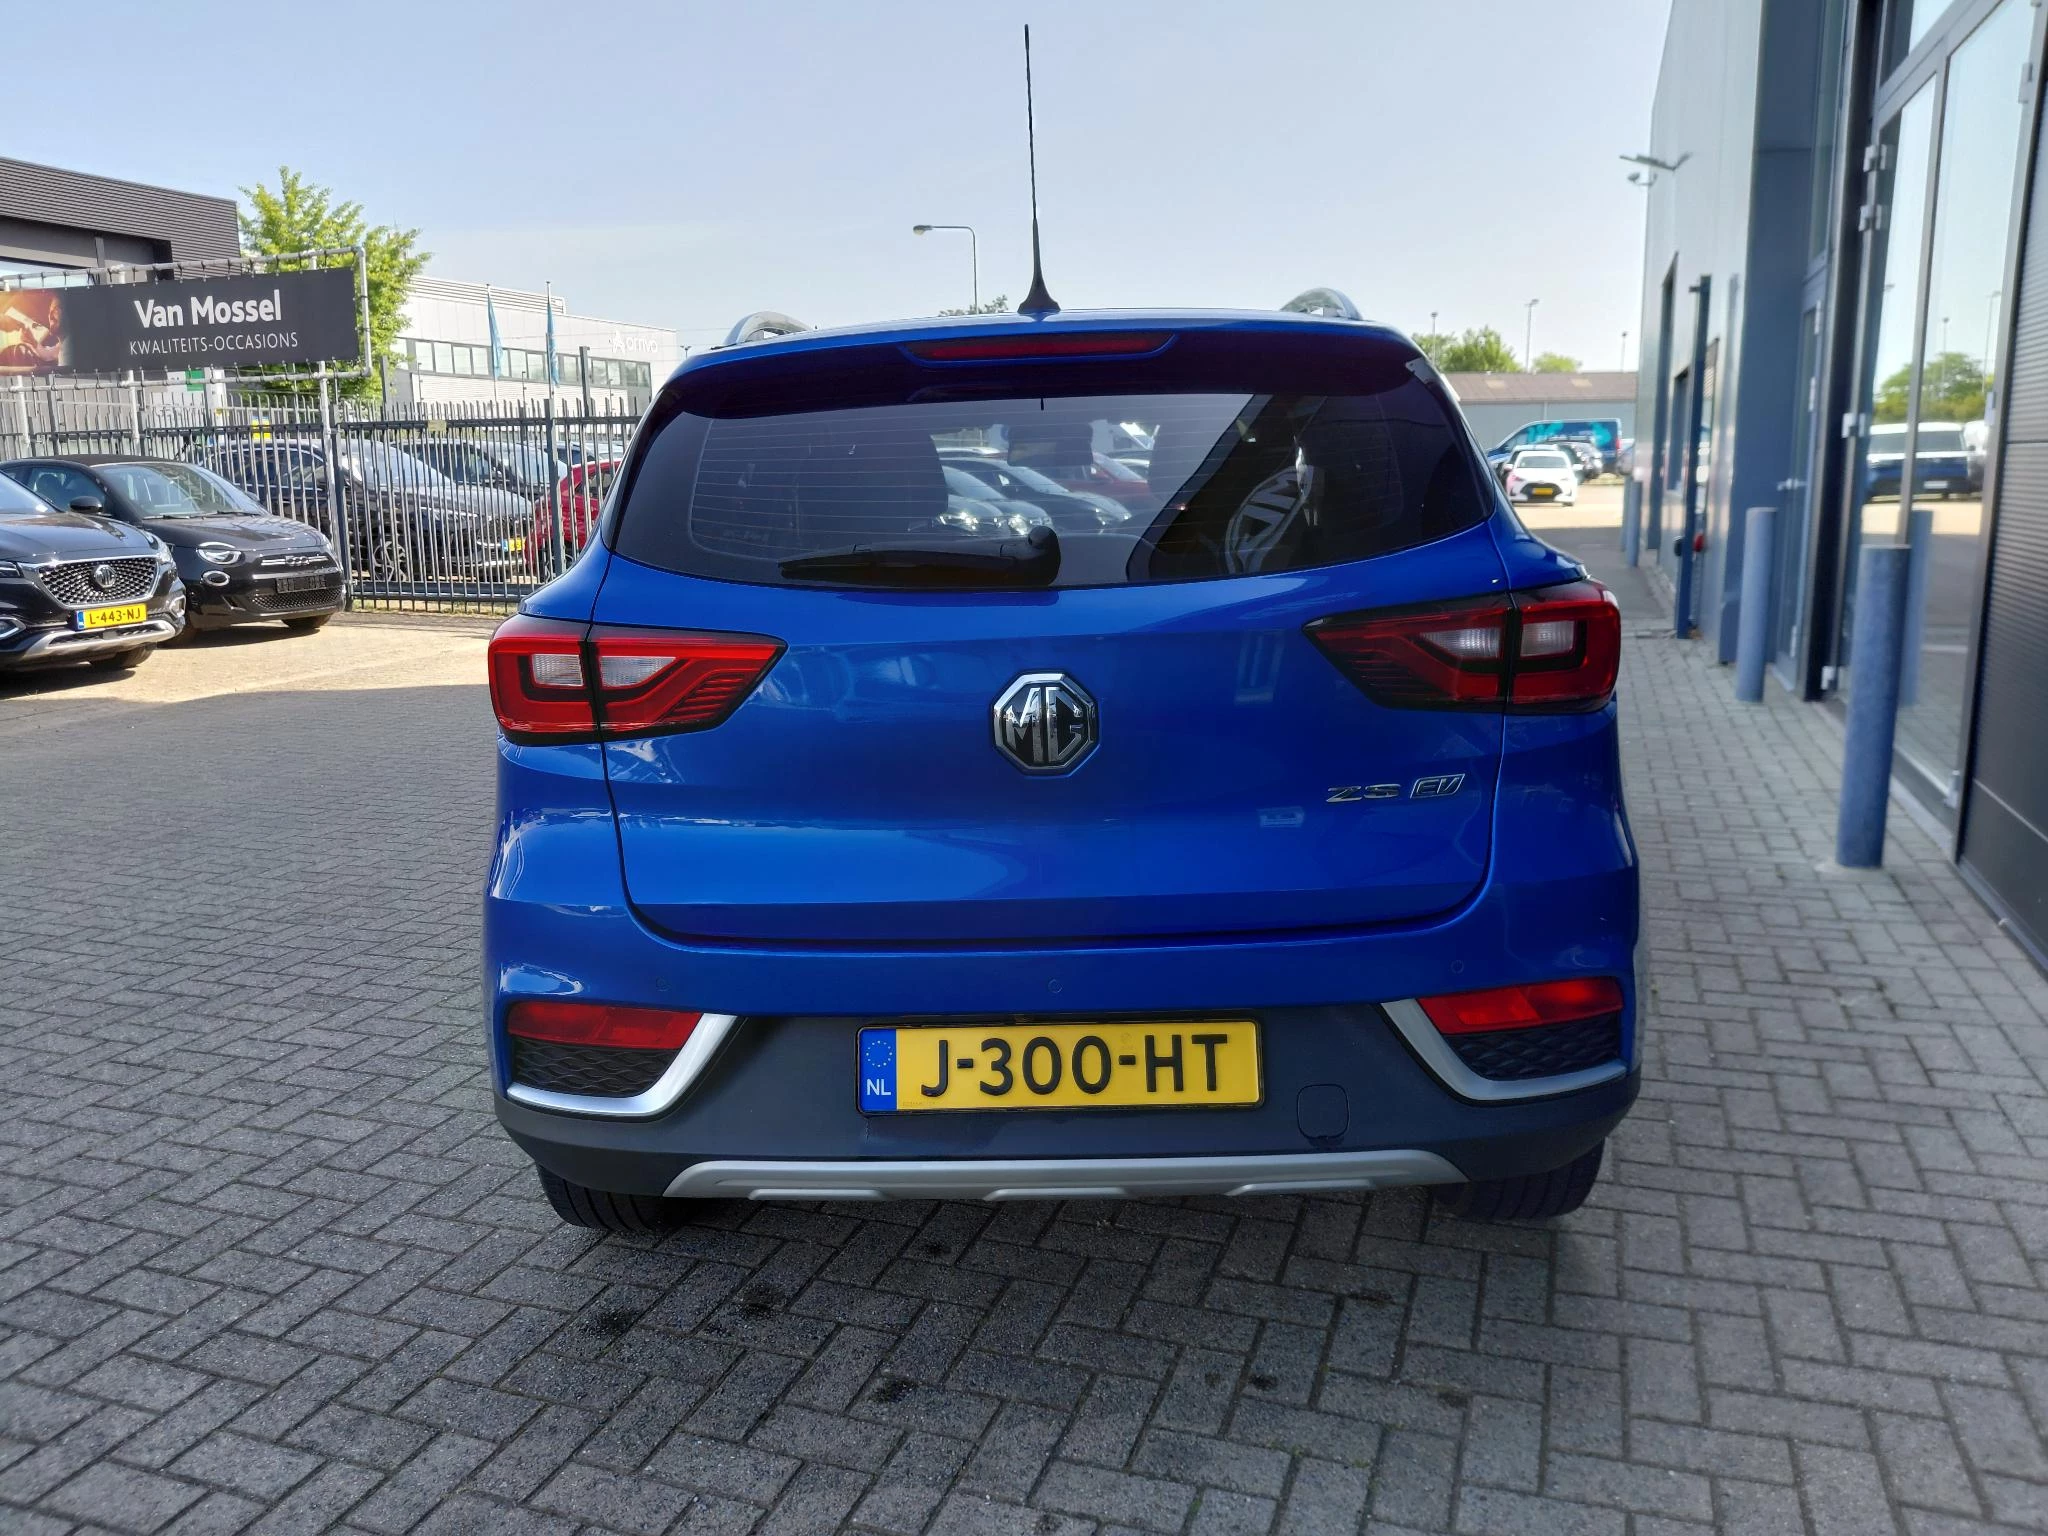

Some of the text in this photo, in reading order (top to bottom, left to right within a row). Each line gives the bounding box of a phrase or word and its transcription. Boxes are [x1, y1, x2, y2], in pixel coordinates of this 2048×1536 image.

[133, 289, 282, 329] Van Mossel
[129, 331, 299, 356] KWALITEITS-OCCASIONS
[88, 607, 142, 626] L-443-NJ
[1000, 683, 1086, 765] MG
[1326, 776, 1462, 803] ZS EV
[920, 1033, 1229, 1098] J-300-HT
[866, 1078, 892, 1096] NL
